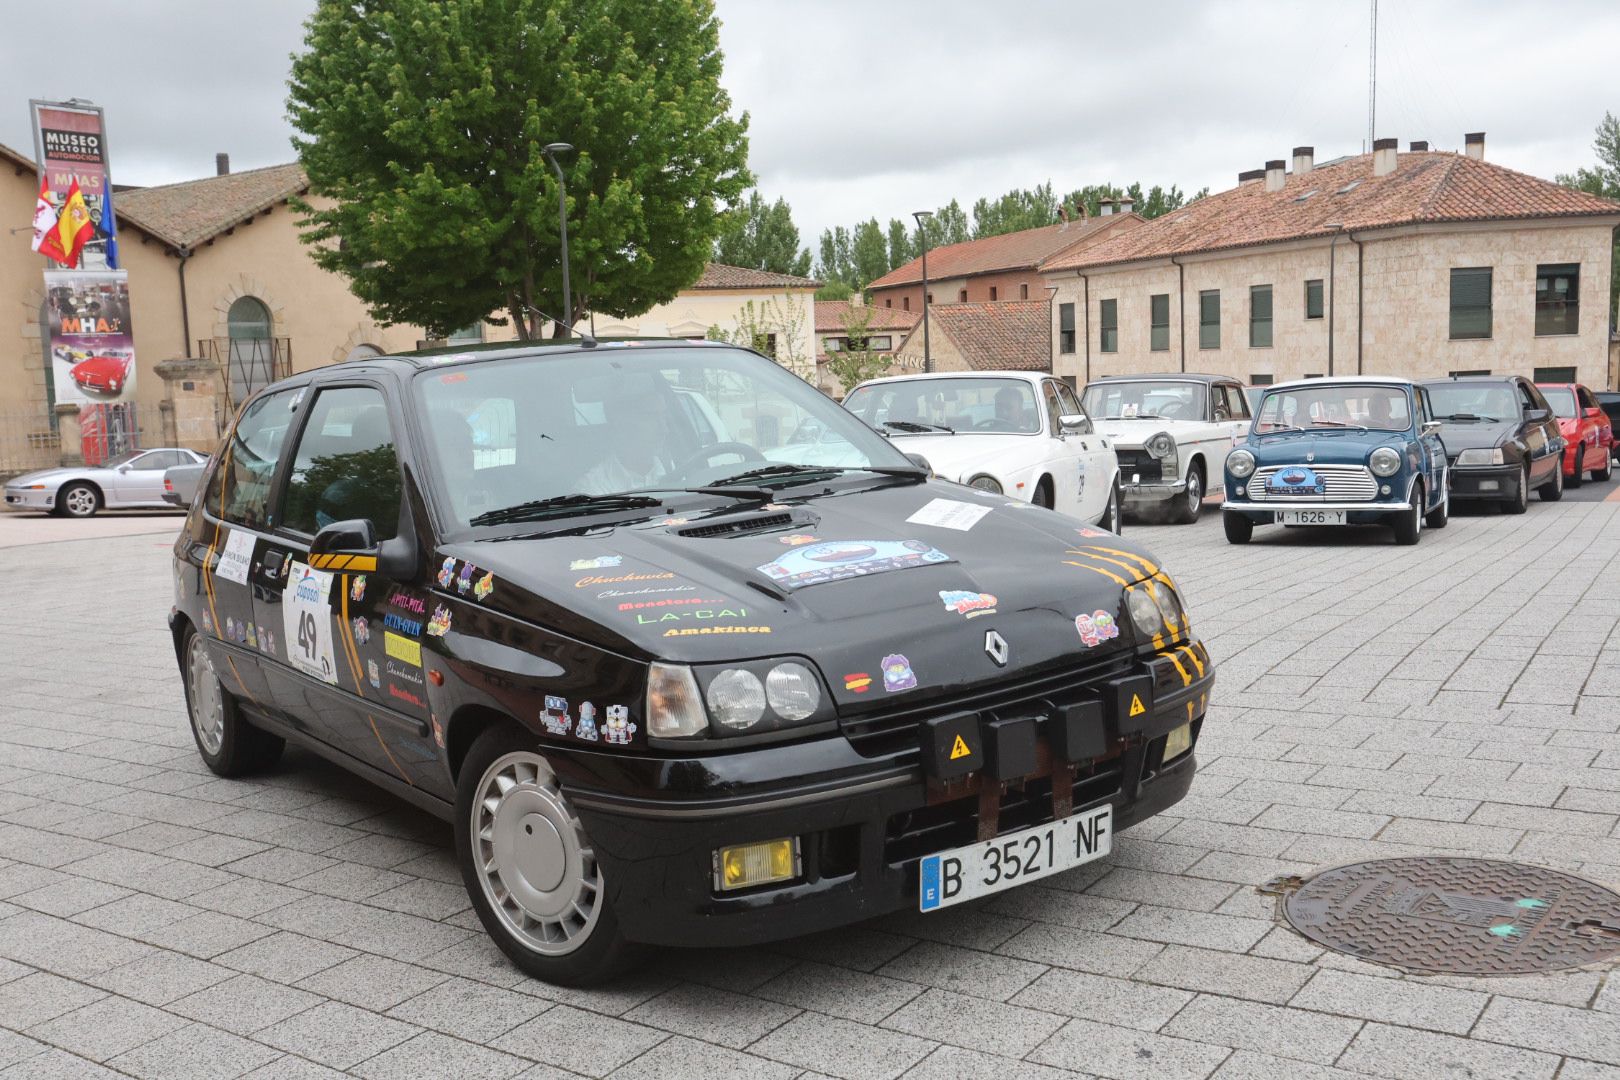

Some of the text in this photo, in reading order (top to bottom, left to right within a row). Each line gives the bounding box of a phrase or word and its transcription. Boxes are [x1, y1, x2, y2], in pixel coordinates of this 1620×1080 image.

[47, 132, 98, 147] MUSEO
[47, 143, 99, 155] HISTORIA
[1295, 511, 1325, 523] 1626
[298, 610, 316, 660] 49
[942, 811, 1109, 899] B 3521 NF
[927, 888, 935, 900] E
